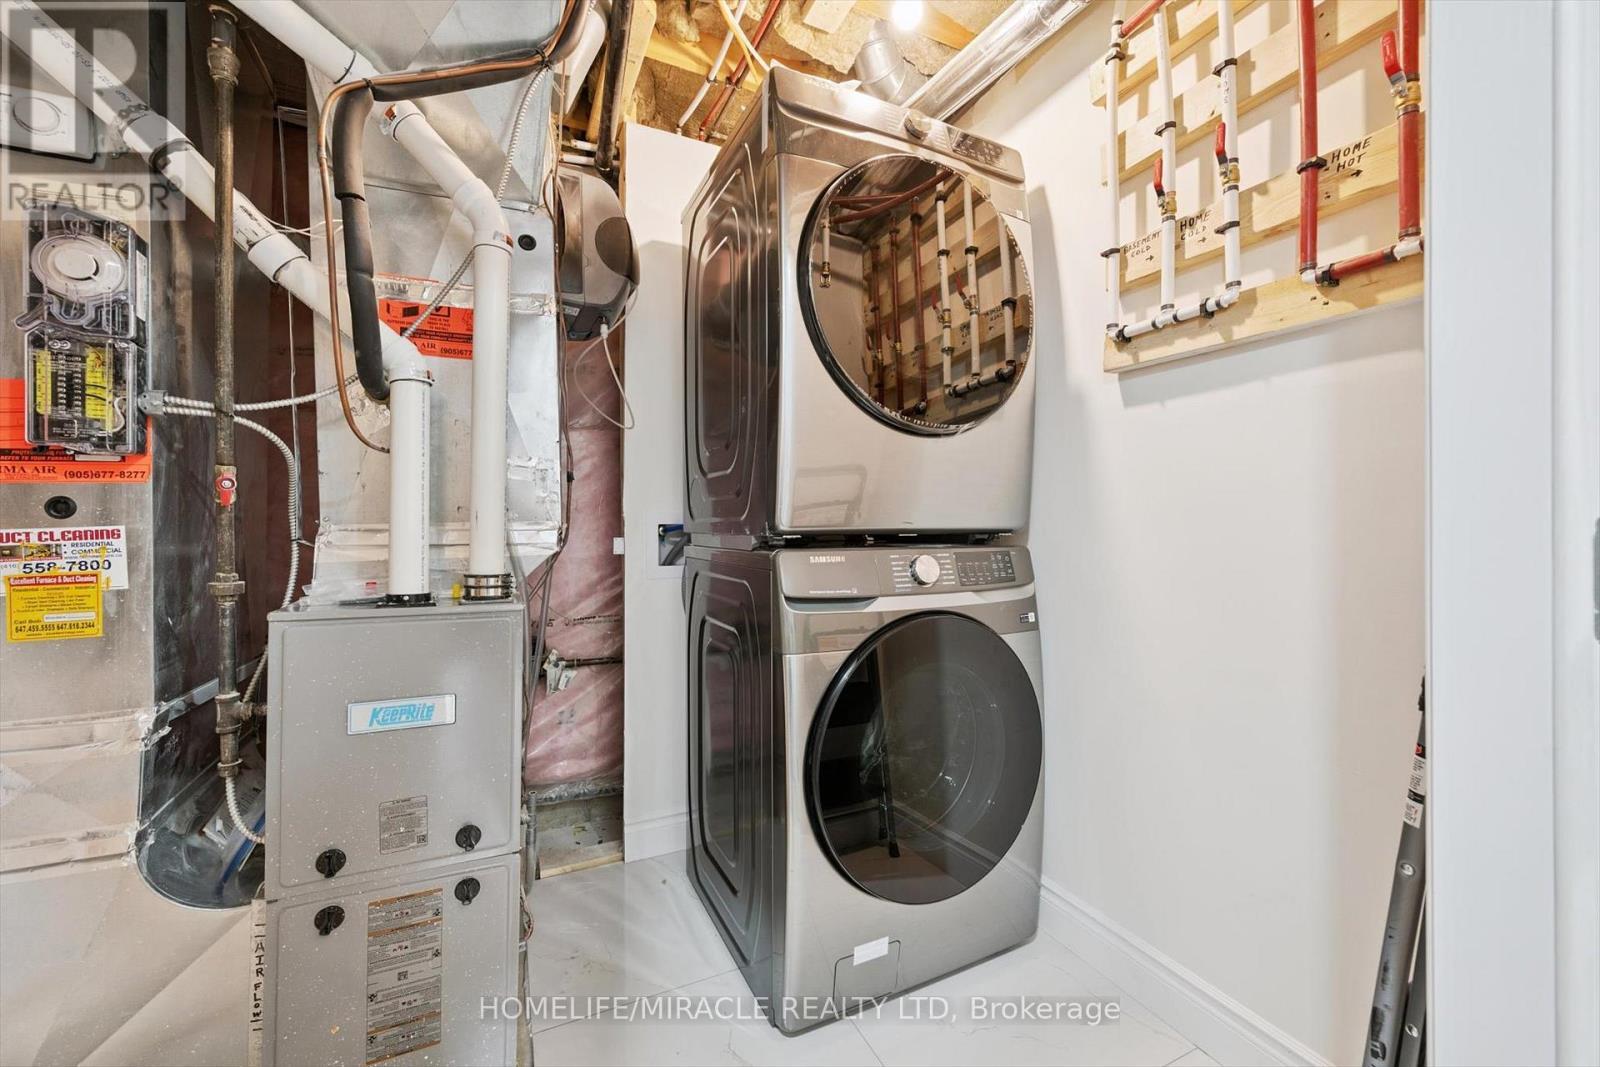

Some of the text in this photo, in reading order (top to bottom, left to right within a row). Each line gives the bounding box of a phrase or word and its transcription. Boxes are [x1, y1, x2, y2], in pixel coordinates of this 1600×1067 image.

[1331, 136, 1372, 163] HOME
[1336, 152, 1368, 172] HOT
[1180, 210, 1212, 232] HOME
[1180, 226, 1207, 240] COLD
[1123, 231, 1160, 254] BASEMENT
[1131, 246, 1151, 258] COLD
[31, 465, 57, 474] AIR
[64, 470, 146, 479] (905)677-8277
[37, 528, 121, 542] CLEANING
[809, 555, 846, 563] SAMSUNG
[22, 559, 112, 574] 558-7800
[10, 577, 36, 586] Excellent
[63, 575, 74, 583] Duct
[75, 575, 97, 583] Cleaning
[252, 942, 265, 1018] AIR FLOW
